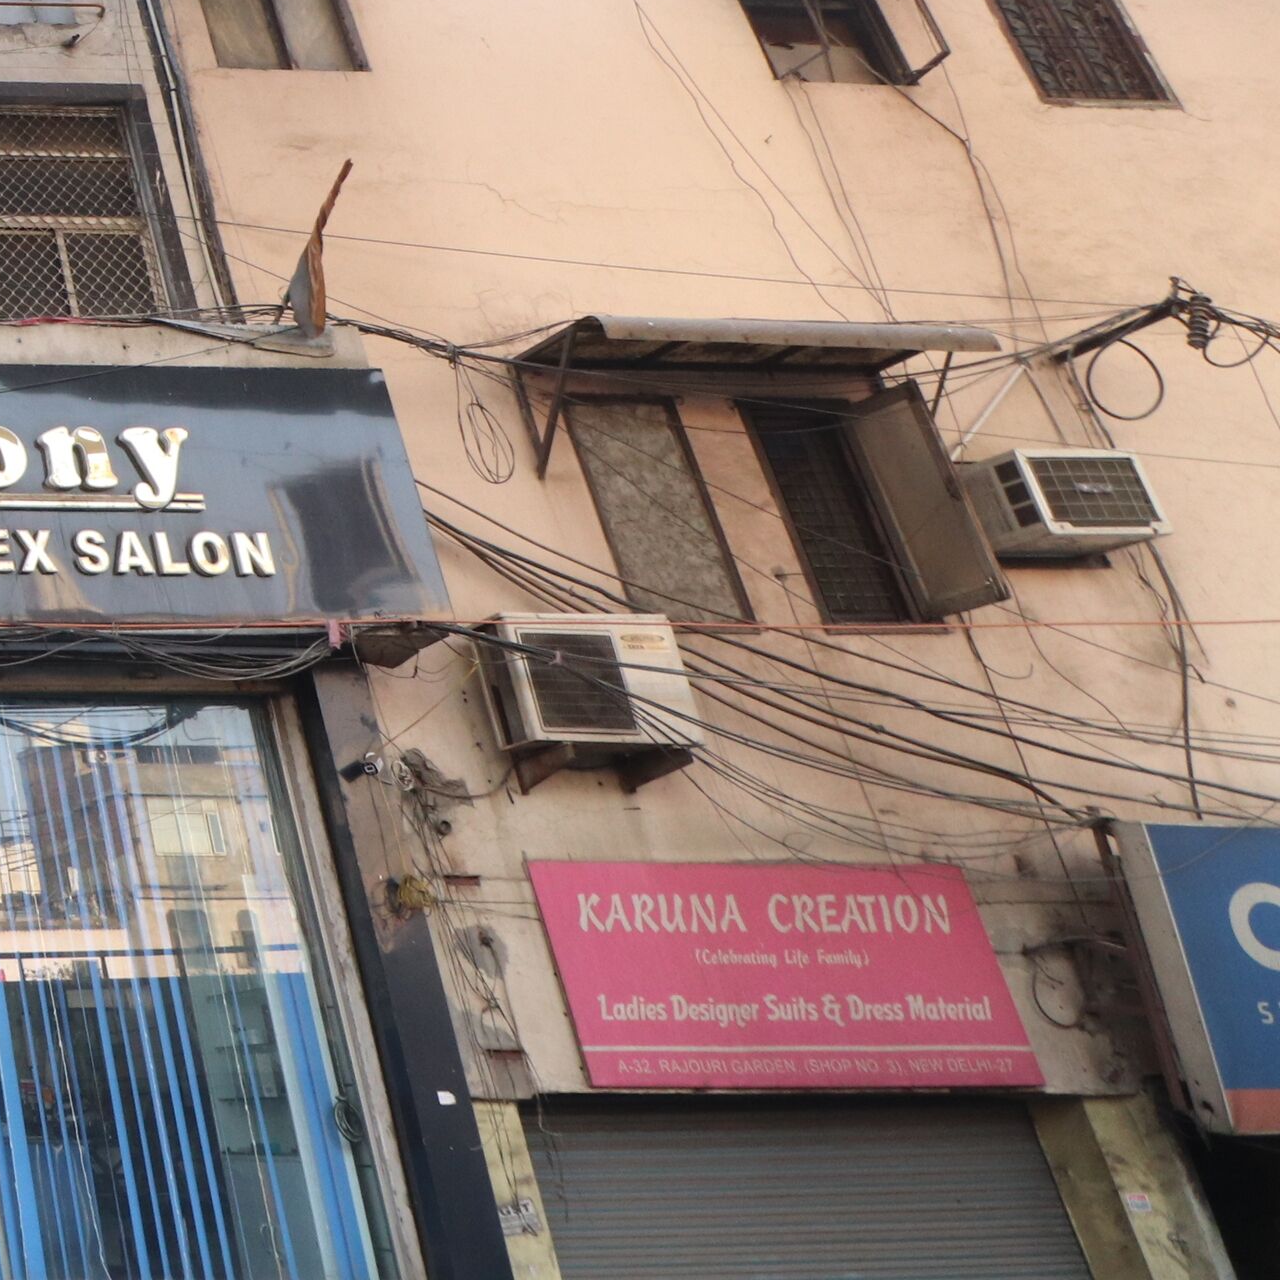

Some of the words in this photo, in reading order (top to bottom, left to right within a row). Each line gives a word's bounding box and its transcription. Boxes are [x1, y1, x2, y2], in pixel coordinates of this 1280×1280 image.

[74, 528, 277, 578] SALON
[577, 893, 748, 934] KARUNA
[767, 893, 952, 936] CREATION
[695, 949, 778, 968] (Celebrating
[784, 949, 810, 967] Life
[817, 949, 870, 968] Family)
[598, 994, 667, 1022] Ladies
[670, 995, 759, 1027] Designer
[765, 995, 819, 1022] Suits
[822, 994, 842, 1027] &
[847, 995, 904, 1022] Dress
[905, 995, 993, 1022] Material
[658, 1058, 728, 1075] RAJOURI
[804, 1058, 854, 1076] (SHOP
[908, 1058, 945, 1075] NEW
[947, 1058, 1015, 1075] DELHI-27
